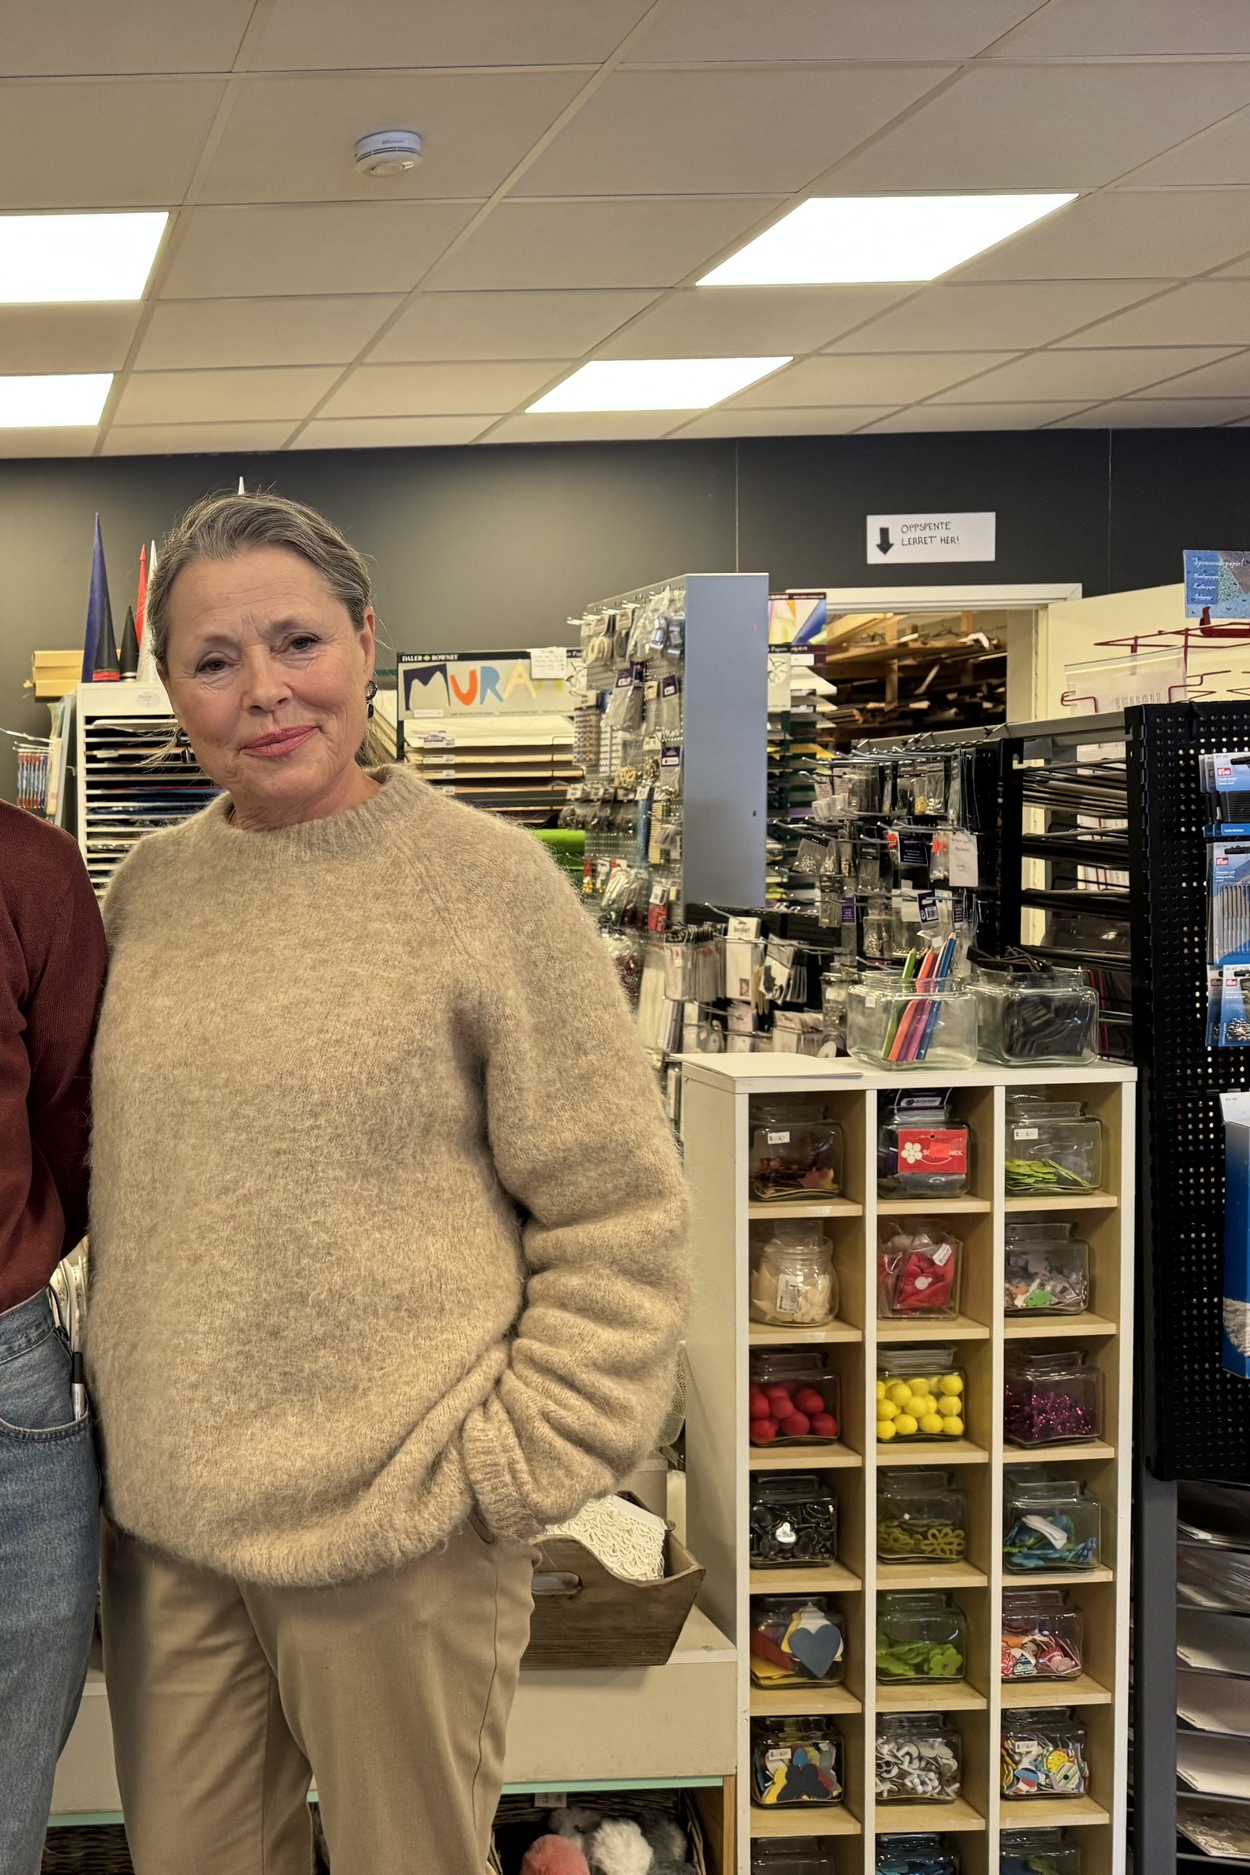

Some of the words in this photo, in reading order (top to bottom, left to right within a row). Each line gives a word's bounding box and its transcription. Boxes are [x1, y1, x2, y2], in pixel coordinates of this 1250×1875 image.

[900, 521, 951, 534] OPPSPENTE
[940, 535, 960, 545] HER!
[403, 658, 565, 712] MURA
